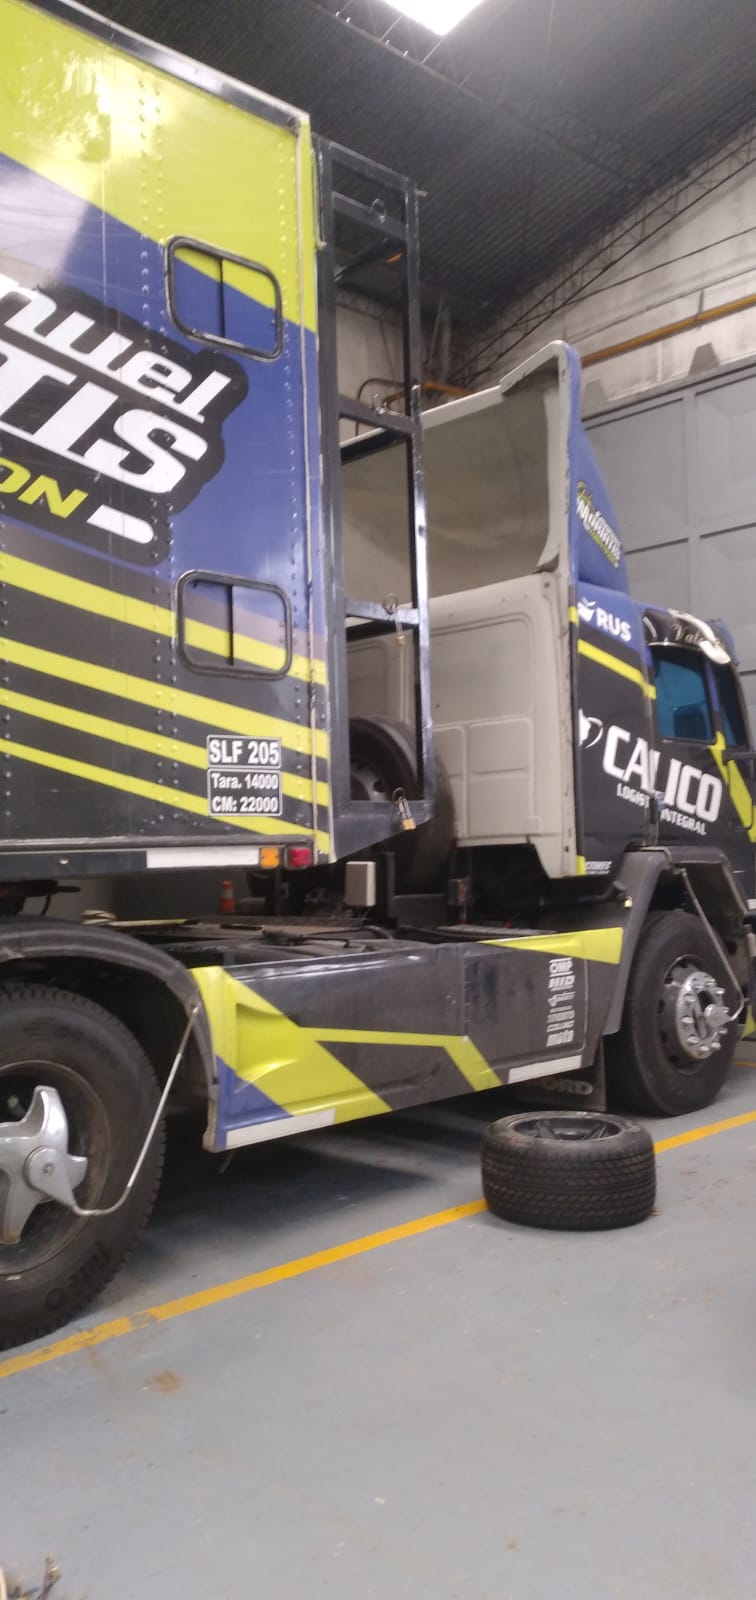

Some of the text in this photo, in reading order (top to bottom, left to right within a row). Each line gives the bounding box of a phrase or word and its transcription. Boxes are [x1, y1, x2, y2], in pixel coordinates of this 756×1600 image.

[596, 608, 632, 642] RUS
[209, 739, 280, 765] SLF 205
[211, 772, 278, 789] Tara. 14000
[603, 724, 723, 823] CALICO
[211, 795, 278, 812] CM: 22000
[660, 807, 707, 836] INTEGRAL
[536, 1077, 593, 1096] ORD
